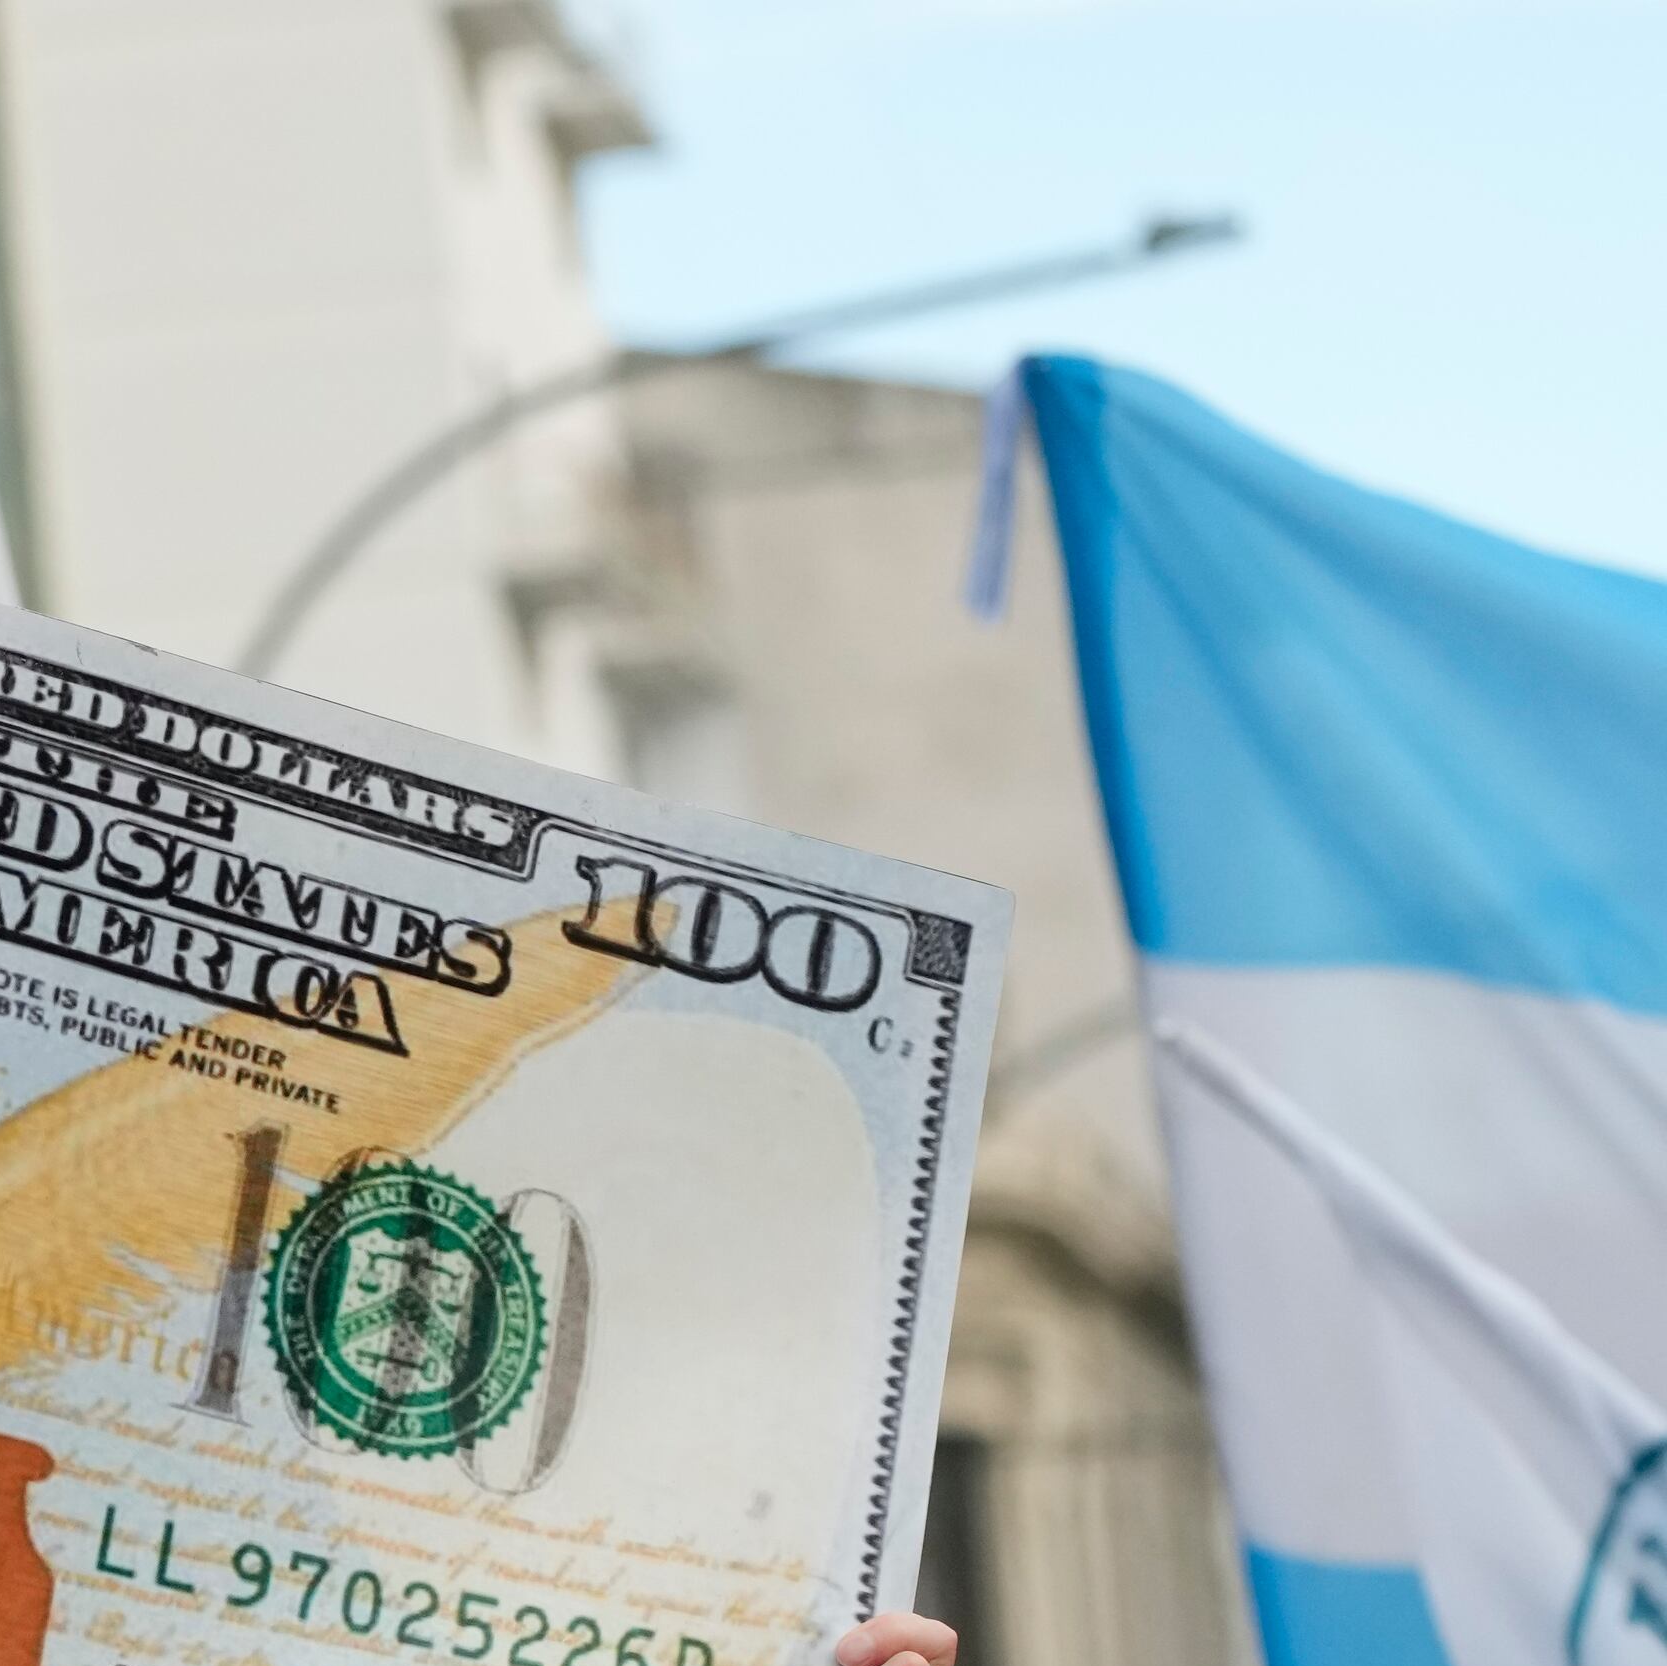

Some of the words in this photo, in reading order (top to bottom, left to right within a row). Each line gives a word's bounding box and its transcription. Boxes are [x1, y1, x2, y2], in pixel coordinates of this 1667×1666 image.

[135, 700, 516, 849] DOLLARS
[97, 817, 512, 997] STATES
[561, 854, 883, 1012] 100
[51, 985, 81, 1011] IS
[86, 993, 172, 1039] LEGAL
[178, 1022, 288, 1071] TENDER
[59, 1014, 165, 1062] PUBLIC
[167, 1049, 229, 1083] AND
[234, 1066, 342, 1116] PRIVATE
